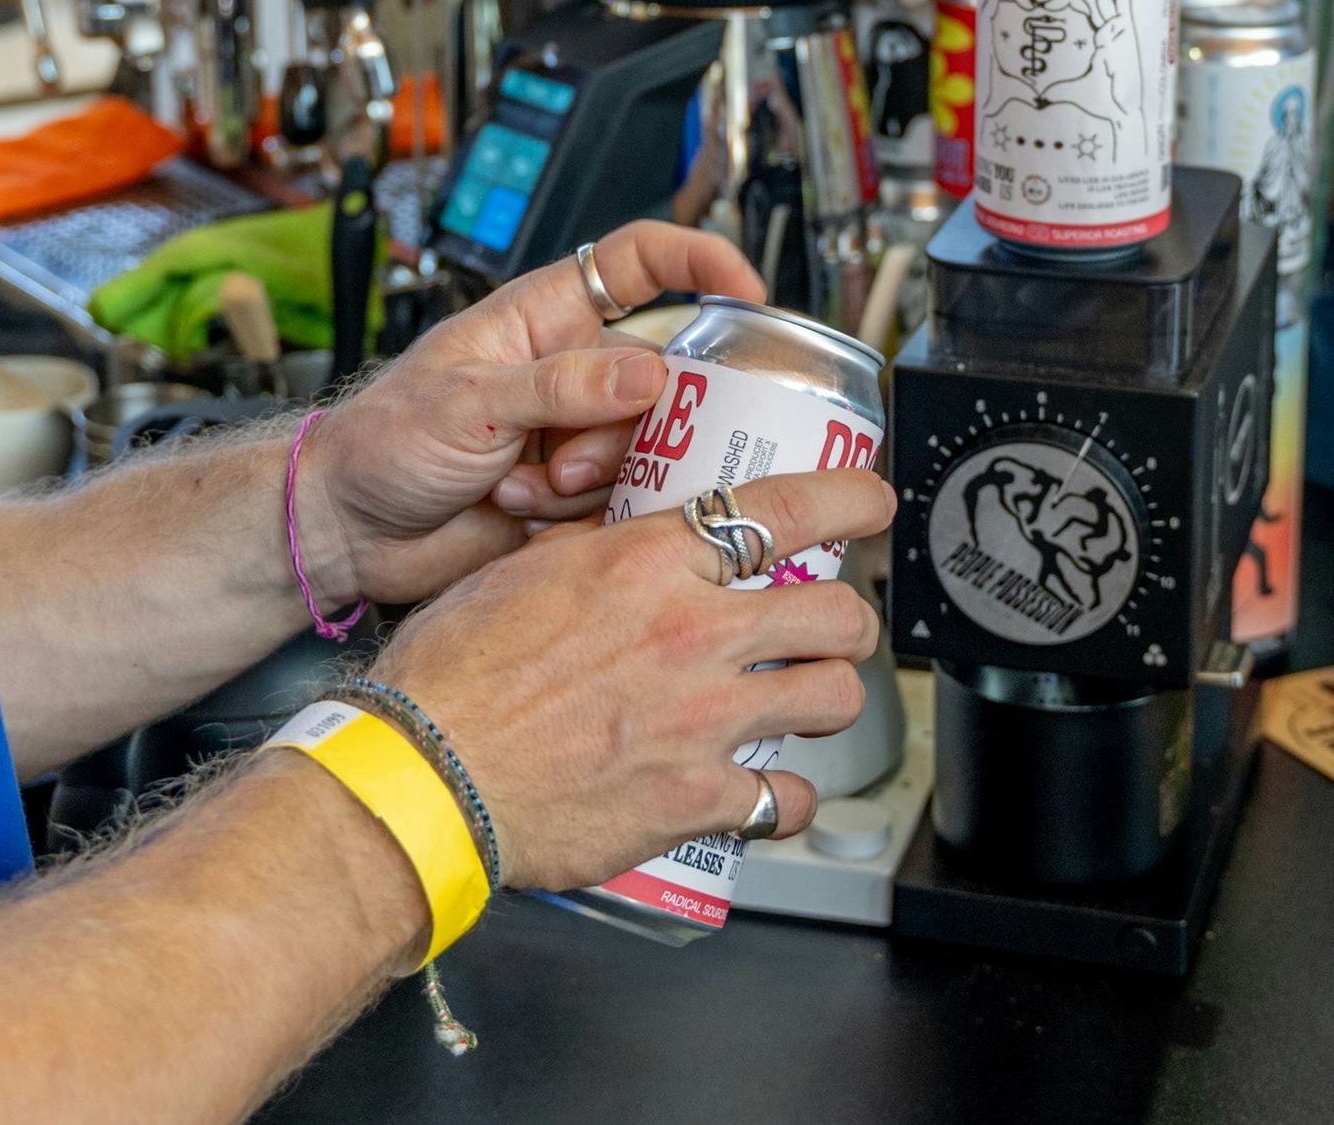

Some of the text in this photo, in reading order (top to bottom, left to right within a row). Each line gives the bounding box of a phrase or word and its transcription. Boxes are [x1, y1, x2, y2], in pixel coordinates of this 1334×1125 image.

[716, 429, 749, 487] WASHED
[940, 541, 1004, 590] PEOPLE
[1159, 575, 1177, 591] 10
[660, 890, 703, 914] RADICAL
